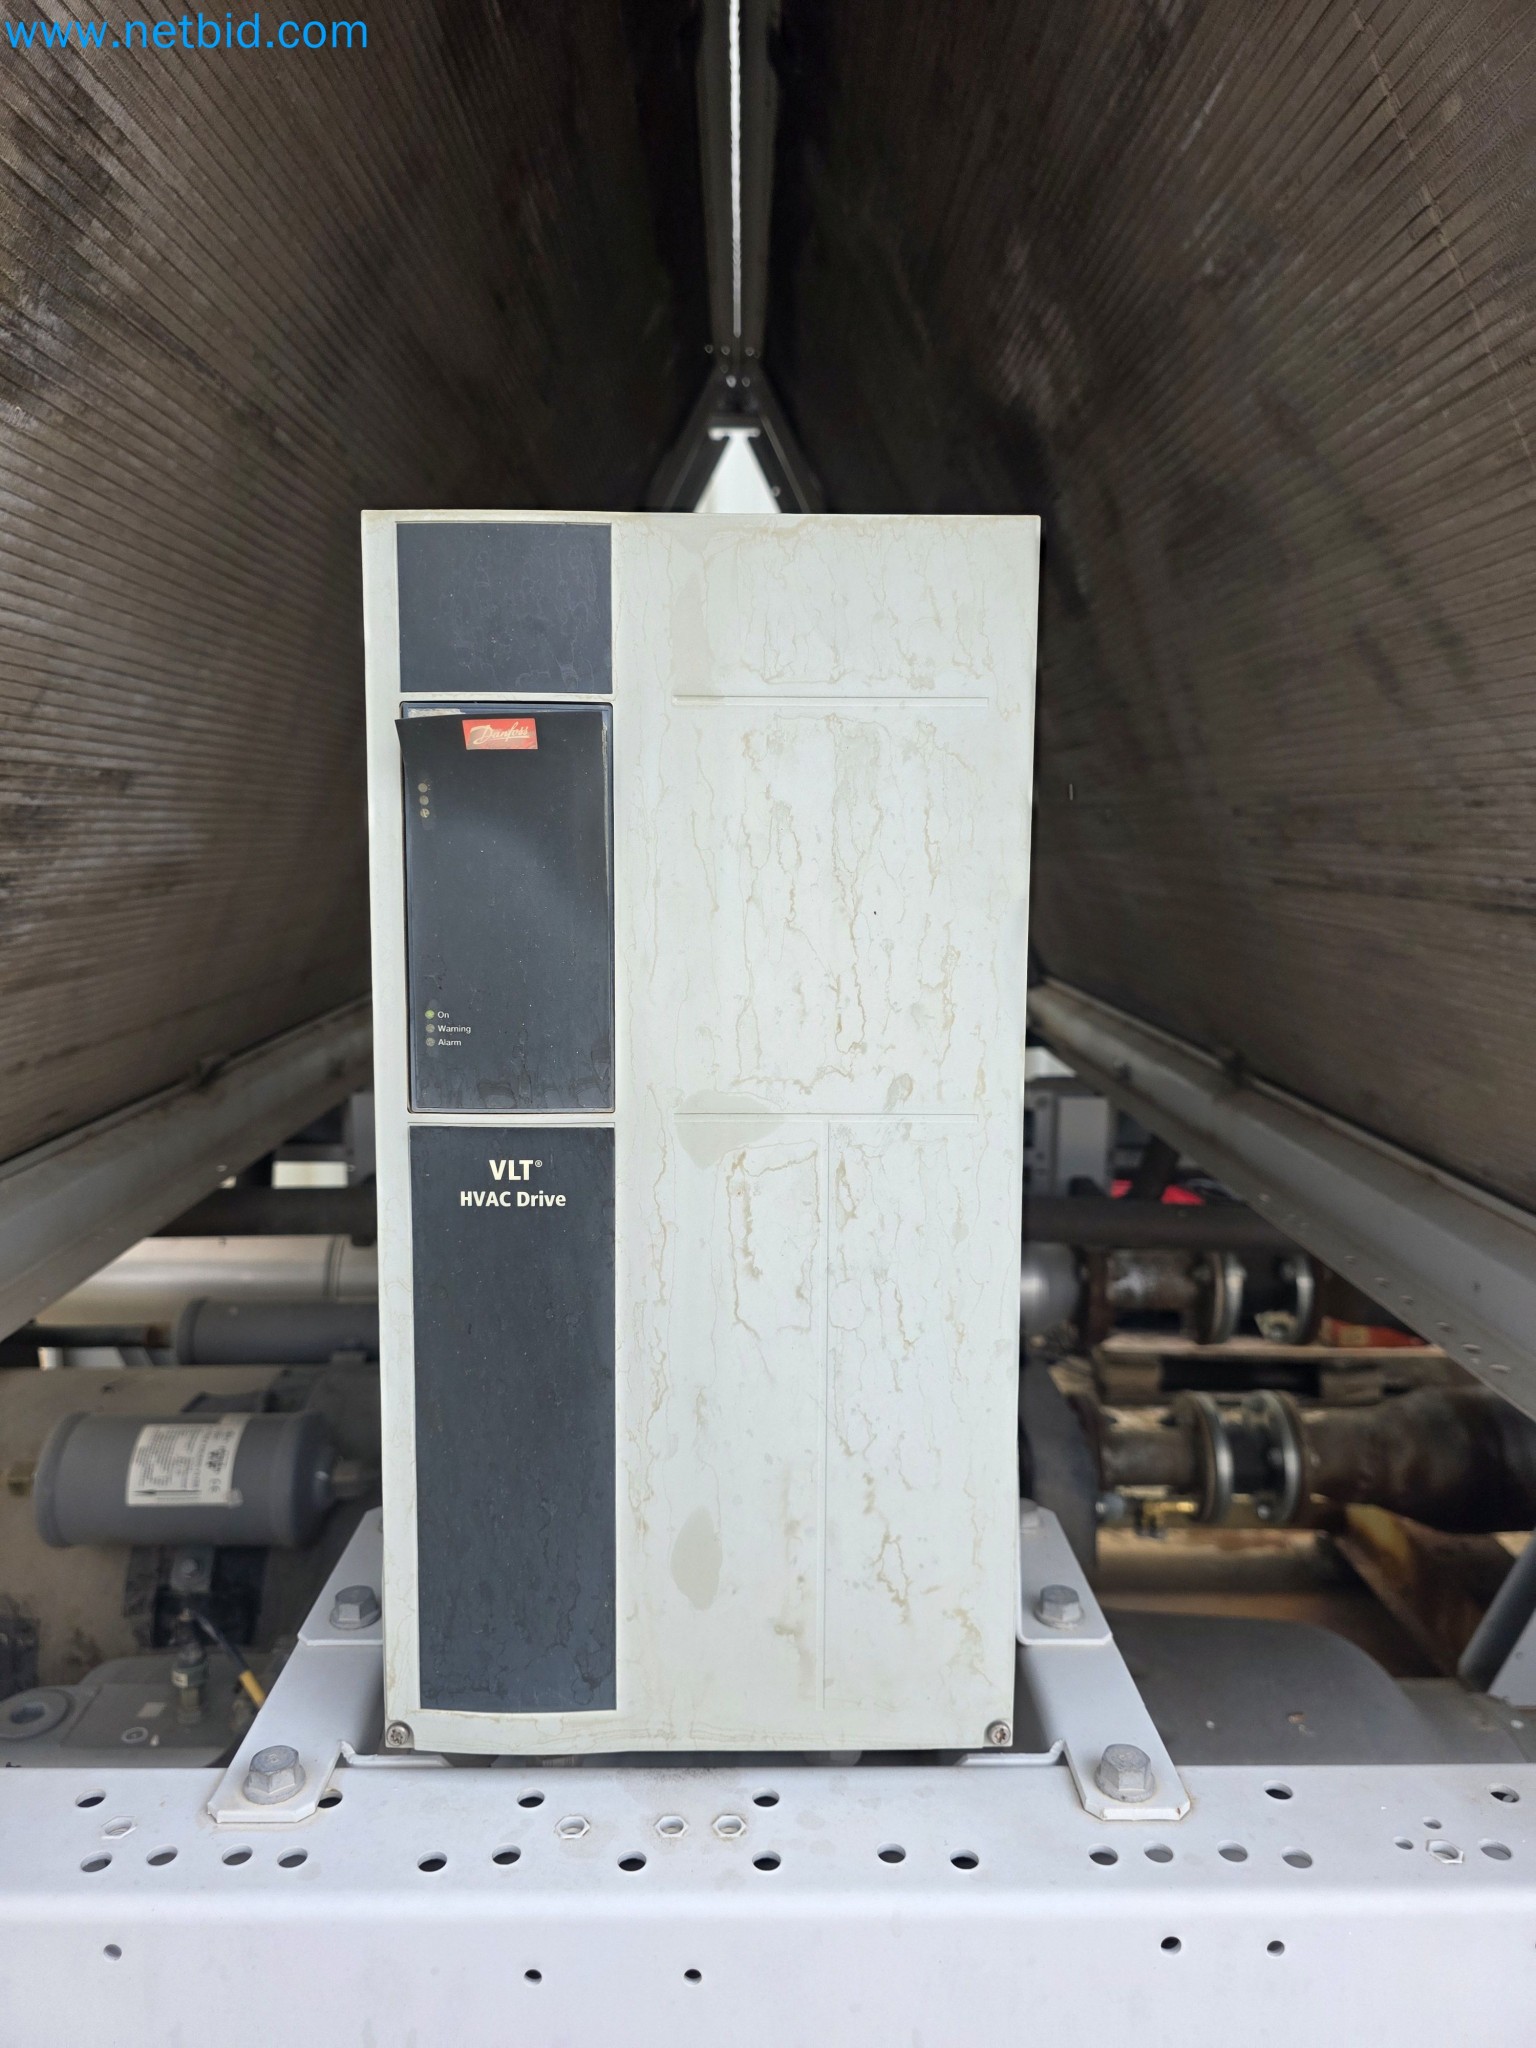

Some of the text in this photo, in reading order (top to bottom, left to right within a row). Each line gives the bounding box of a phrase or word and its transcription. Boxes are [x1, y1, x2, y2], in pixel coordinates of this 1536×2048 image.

[470, 721, 529, 744] Danfoss
[438, 1025, 471, 1034] Warning
[460, 1190, 567, 1207] HVAC Drive
